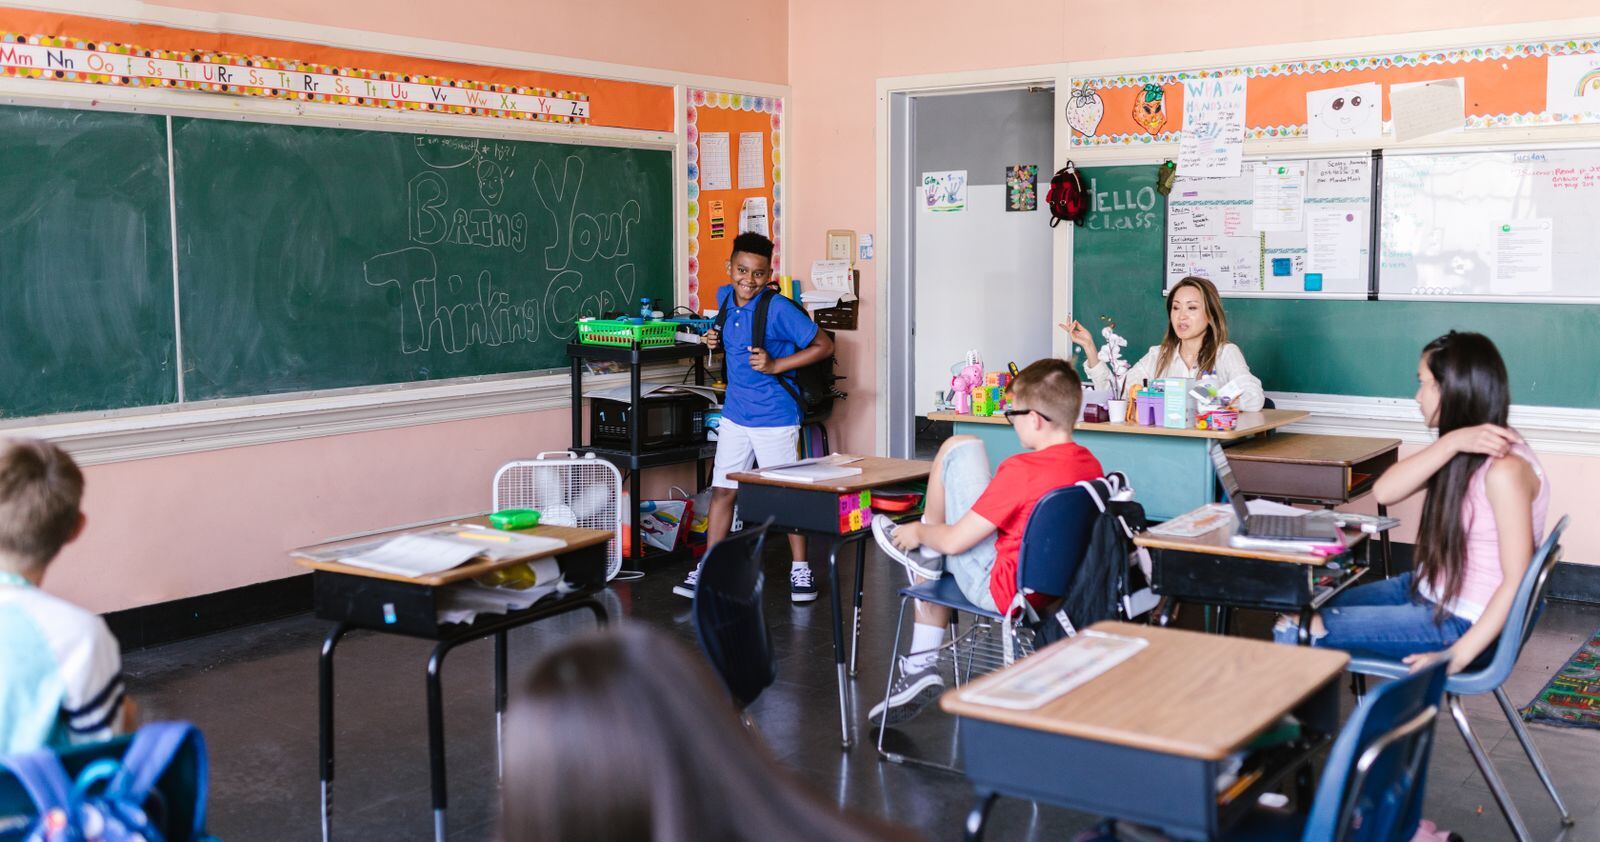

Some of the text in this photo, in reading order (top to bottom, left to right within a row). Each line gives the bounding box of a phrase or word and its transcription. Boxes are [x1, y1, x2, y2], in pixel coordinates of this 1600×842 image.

[0, 46, 33, 66] Mm
[47, 49, 74, 69] Nn
[87, 53, 114, 73] Oo
[147, 60, 163, 77] Ss
[176, 63, 189, 79] Tt
[219, 66, 233, 83] Rr
[249, 69, 265, 86] Ss
[278, 72, 291, 88] Tt
[304, 74, 319, 92] Rr
[335, 77, 350, 95] Ss
[364, 80, 377, 97] Tt
[391, 83, 409, 100] Uu
[431, 87, 447, 103] Vv
[465, 90, 488, 107] Ww
[500, 94, 517, 110] Xx
[538, 97, 551, 115] Yy
[570, 101, 584, 116] Zz
[533, 155, 640, 270] Your
[363, 247, 539, 354] Thinking
